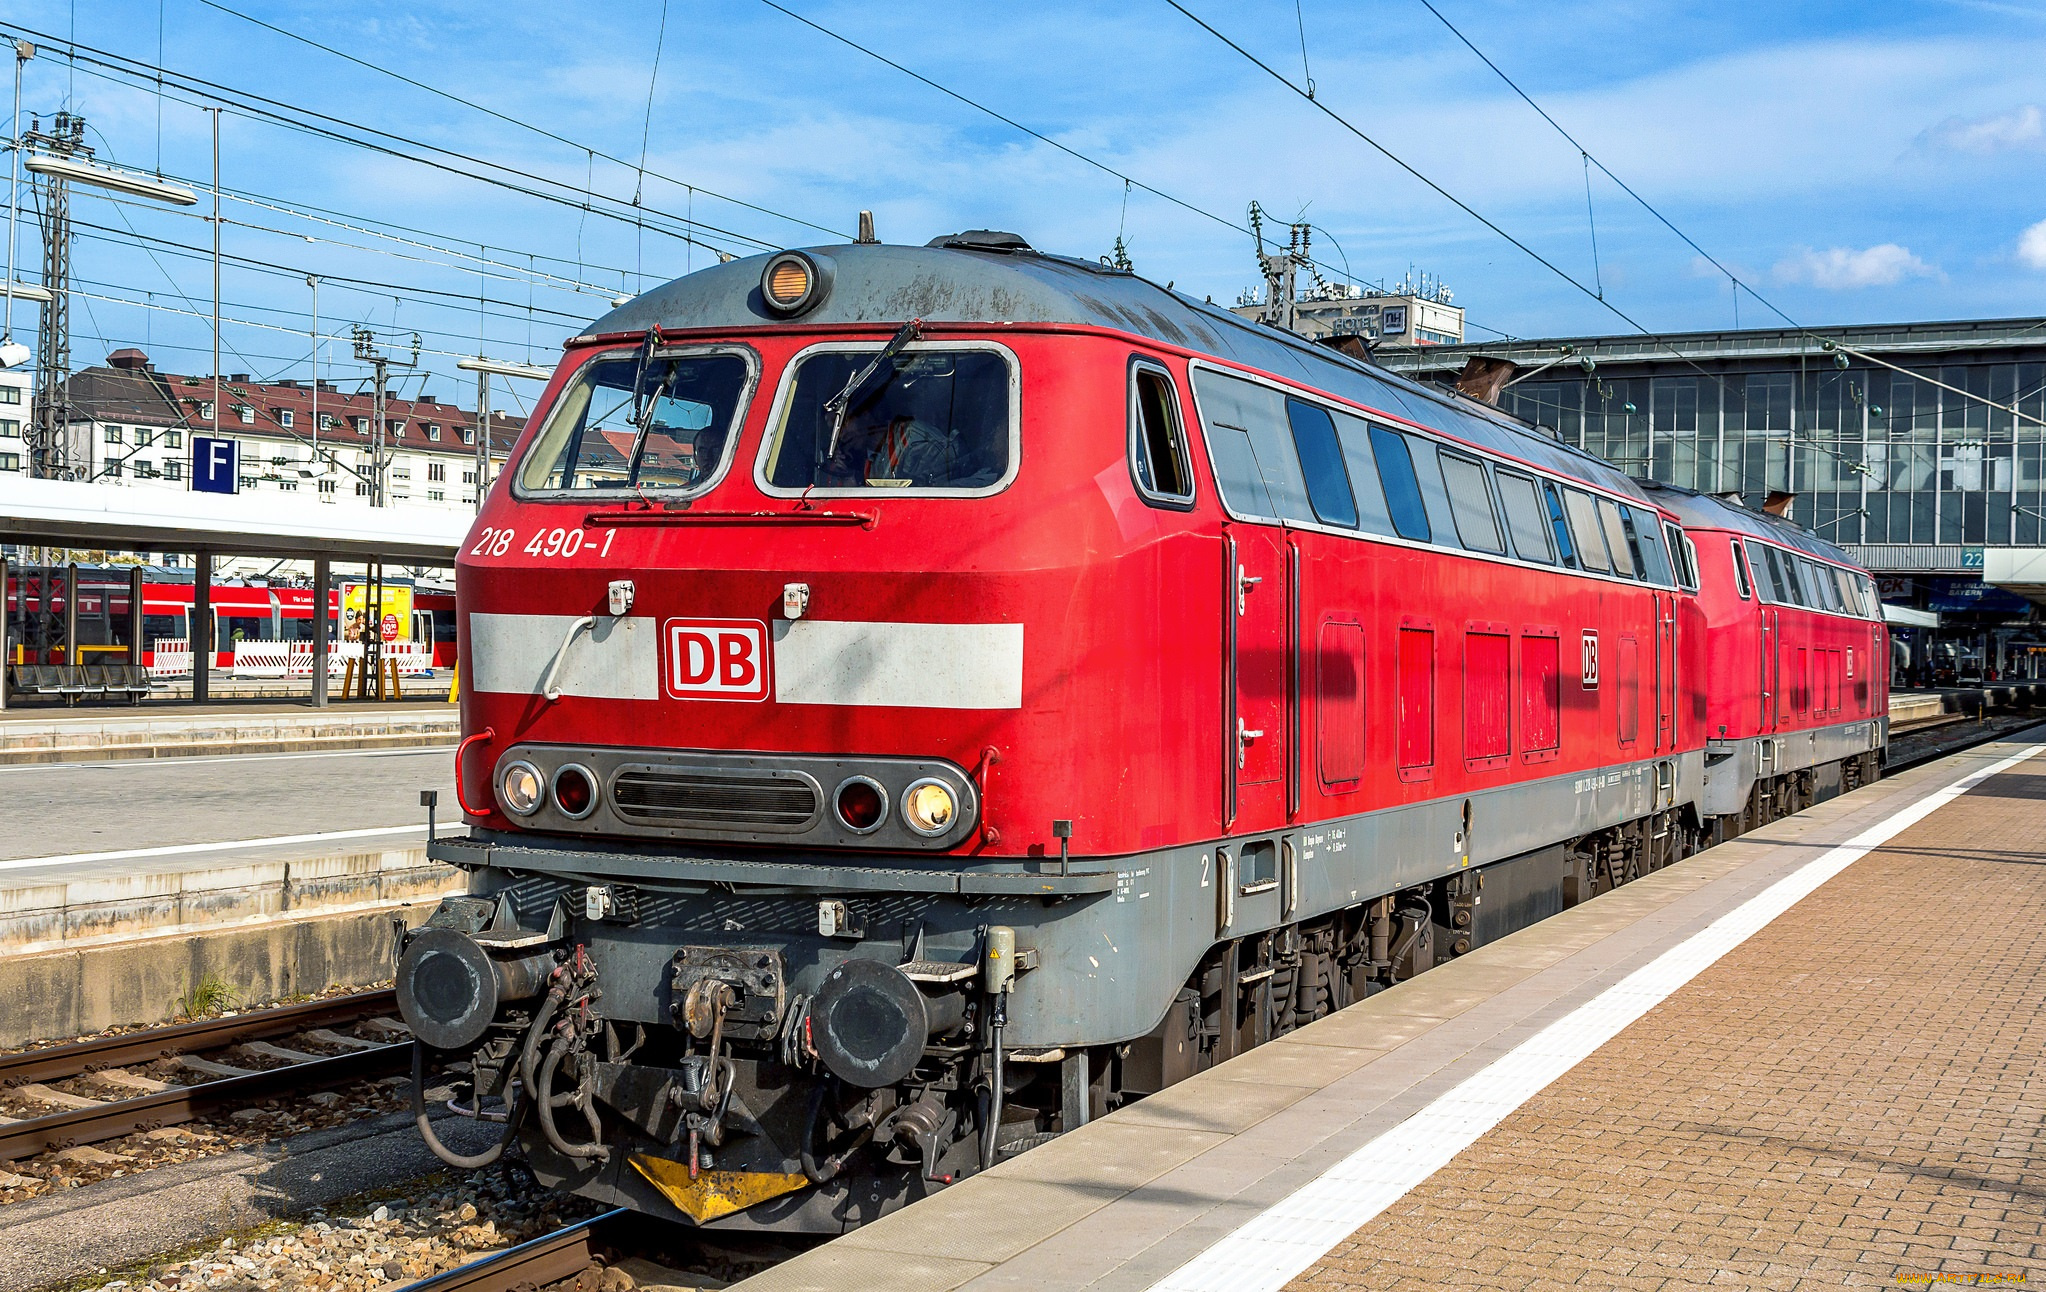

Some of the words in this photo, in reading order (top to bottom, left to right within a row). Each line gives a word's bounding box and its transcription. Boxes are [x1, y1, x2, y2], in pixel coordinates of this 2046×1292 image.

[1334, 317, 1378, 329] HOTEL
[209, 441, 229, 480] F
[470, 526, 515, 557] 218
[523, 528, 616, 558] 490-1
[1965, 553, 1983, 566] 22
[678, 632, 756, 686] DB
[1584, 639, 1597, 679] DB
[1200, 854, 1209, 888] 2
